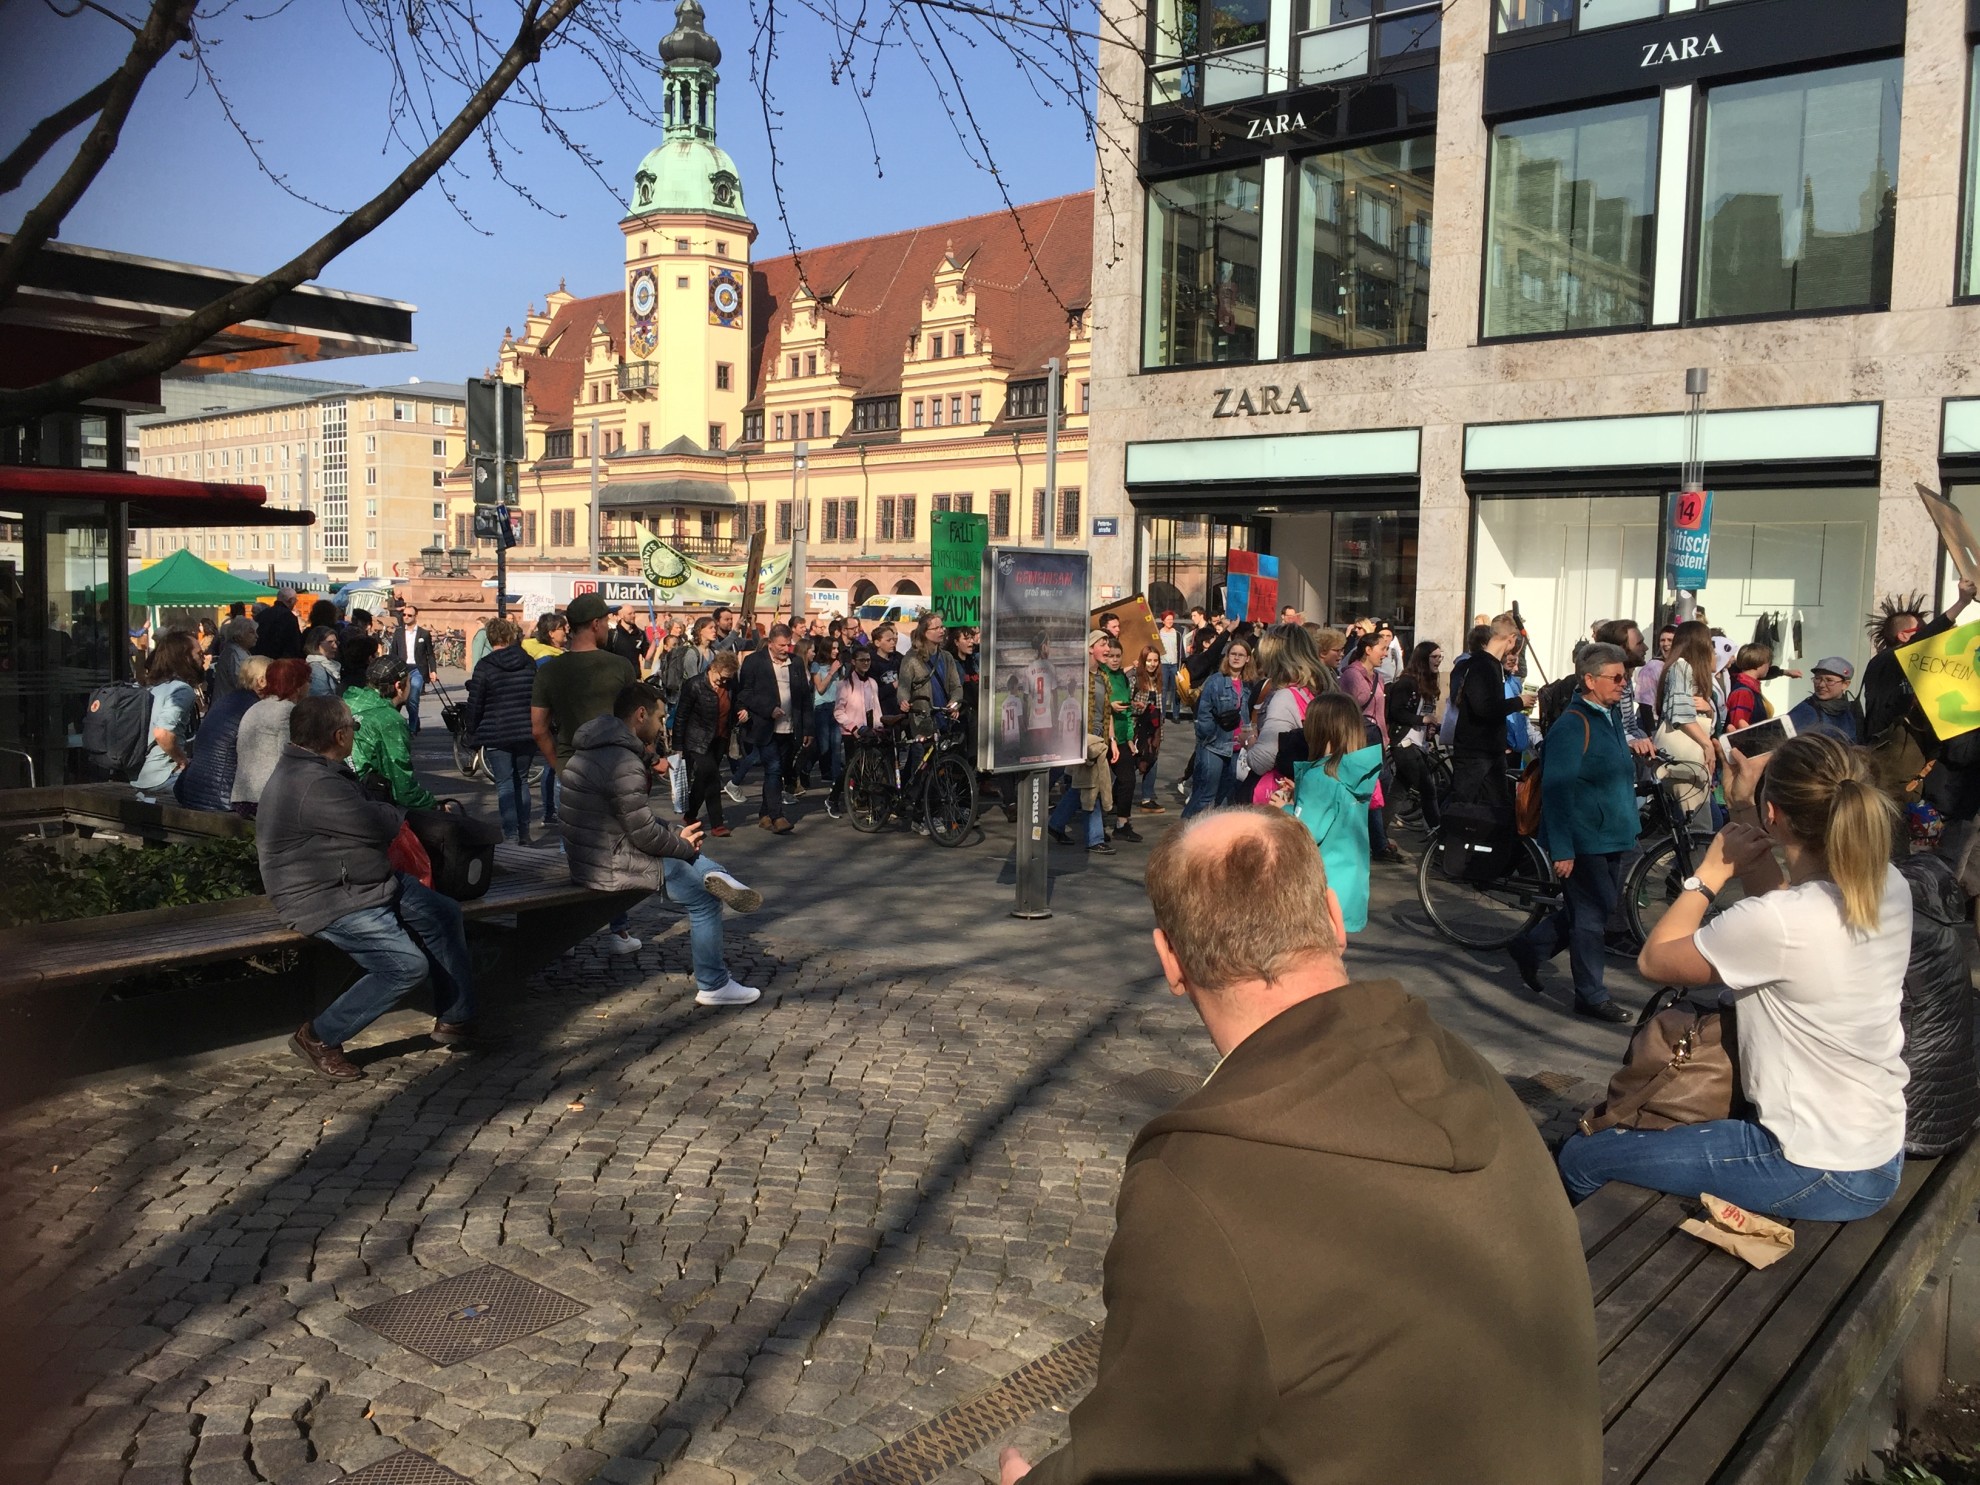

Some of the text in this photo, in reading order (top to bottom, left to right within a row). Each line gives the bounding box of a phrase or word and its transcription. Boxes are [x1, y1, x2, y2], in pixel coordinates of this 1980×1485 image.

[1640, 33, 1723, 67] ZARA
[1246, 111, 1307, 140] ZARA
[1212, 384, 1312, 419] ZARA
[1678, 501, 1696, 521] 14
[642, 543, 657, 581] PARENTS
[932, 549, 981, 571] ENTSCHEIDUNGE
[658, 575, 684, 587] LEIPZIG
[697, 578, 720, 591] uns
[730, 582, 766, 595] ALE
[943, 575, 976, 592] NICHT
[1015, 569, 1073, 586] GEMEINSAM
[818, 592, 840, 600] Pohle
[1024, 586, 1063, 598] groß werden
[1037, 677, 1044, 704] 9
[1006, 709, 1015, 731] 14
